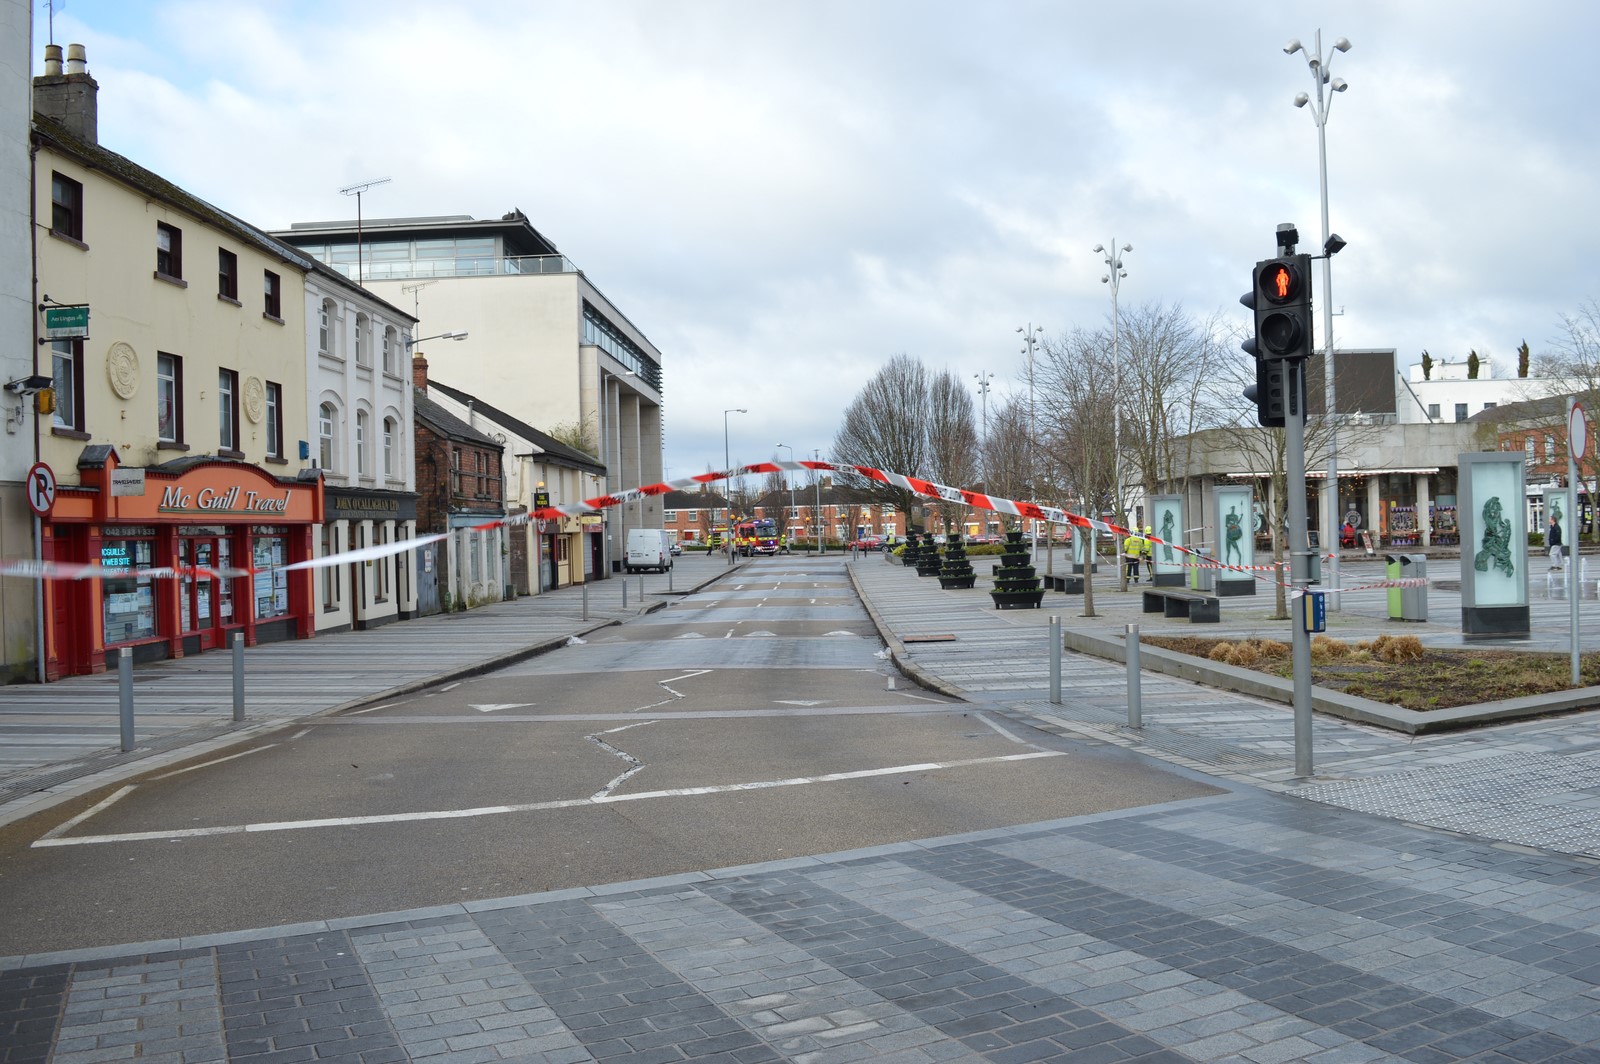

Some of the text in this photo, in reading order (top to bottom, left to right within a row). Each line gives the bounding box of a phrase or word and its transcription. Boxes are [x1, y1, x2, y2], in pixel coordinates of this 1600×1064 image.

[161, 485, 292, 511] Mc Guill Travel
[336, 497, 351, 509] JOHN
